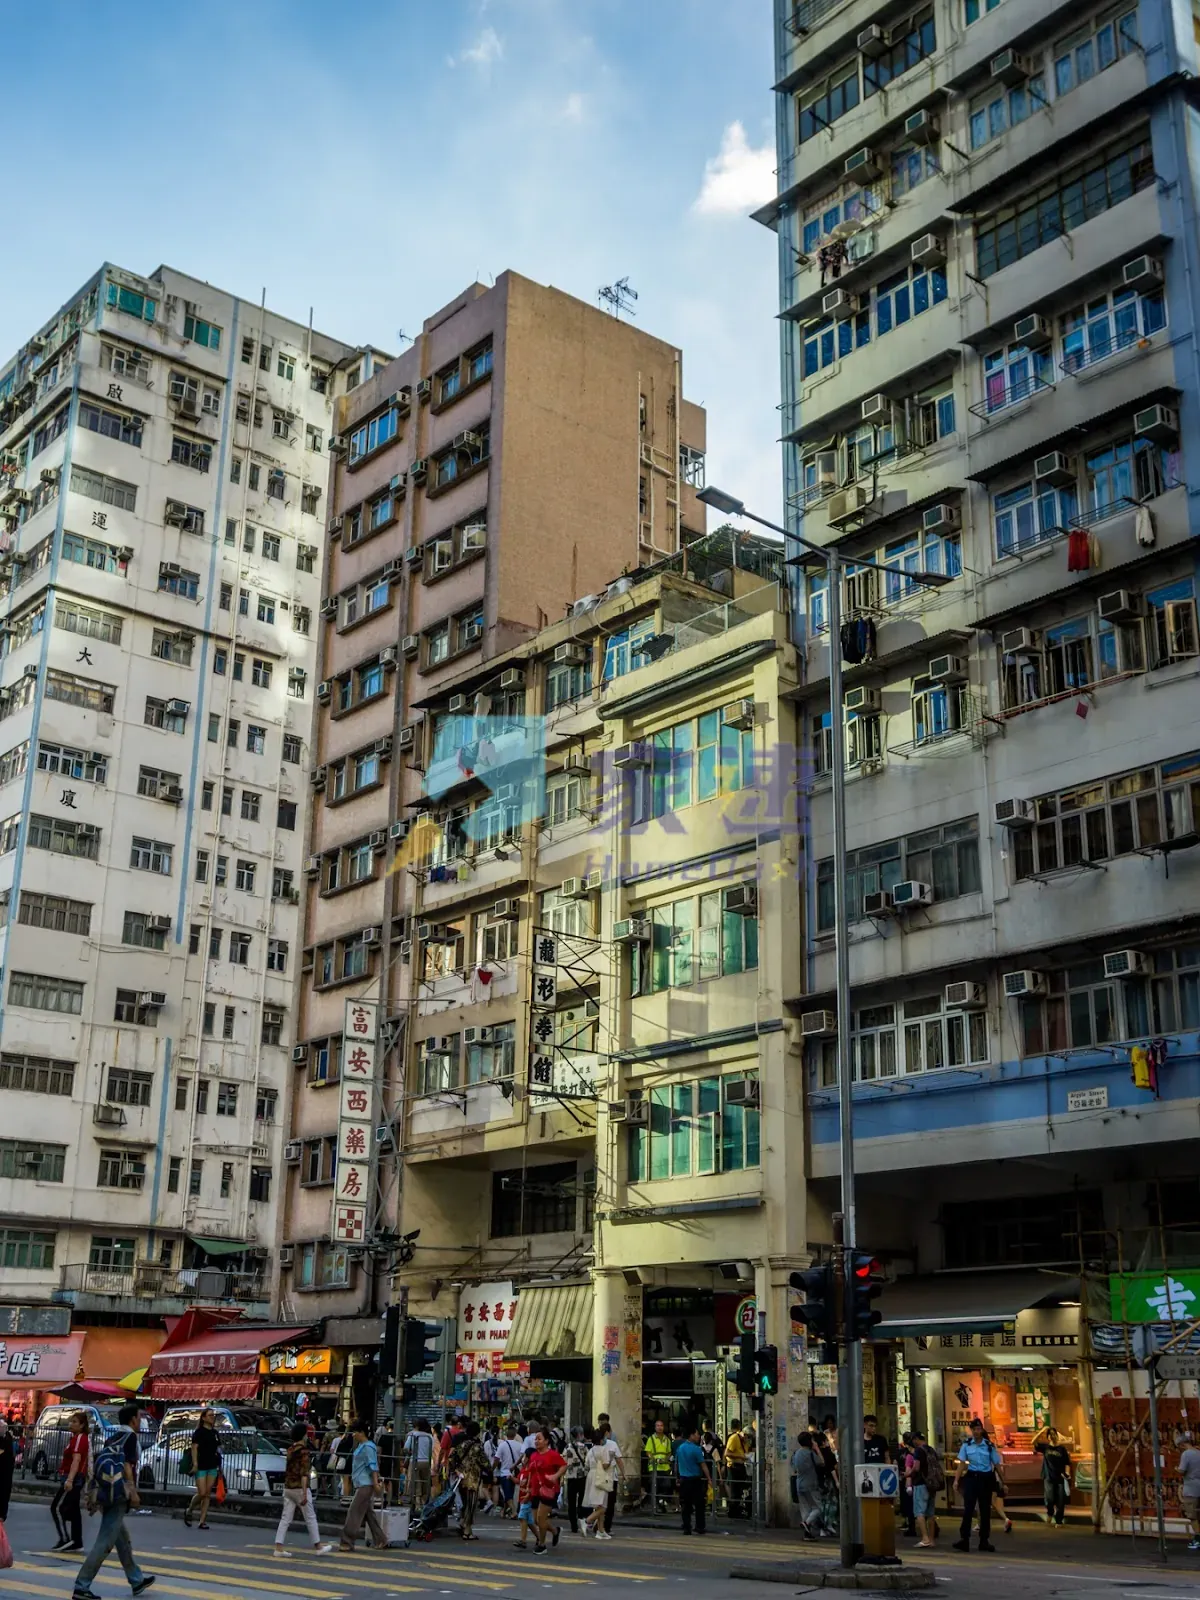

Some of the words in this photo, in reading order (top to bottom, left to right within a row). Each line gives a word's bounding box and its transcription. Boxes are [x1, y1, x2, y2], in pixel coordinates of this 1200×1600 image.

[341, 1006, 371, 1197] 富安西藥房
[464, 1330, 473, 1340] FU
[477, 1330, 486, 1340] ON
[1176, 1357, 1195, 1366] Argyle
